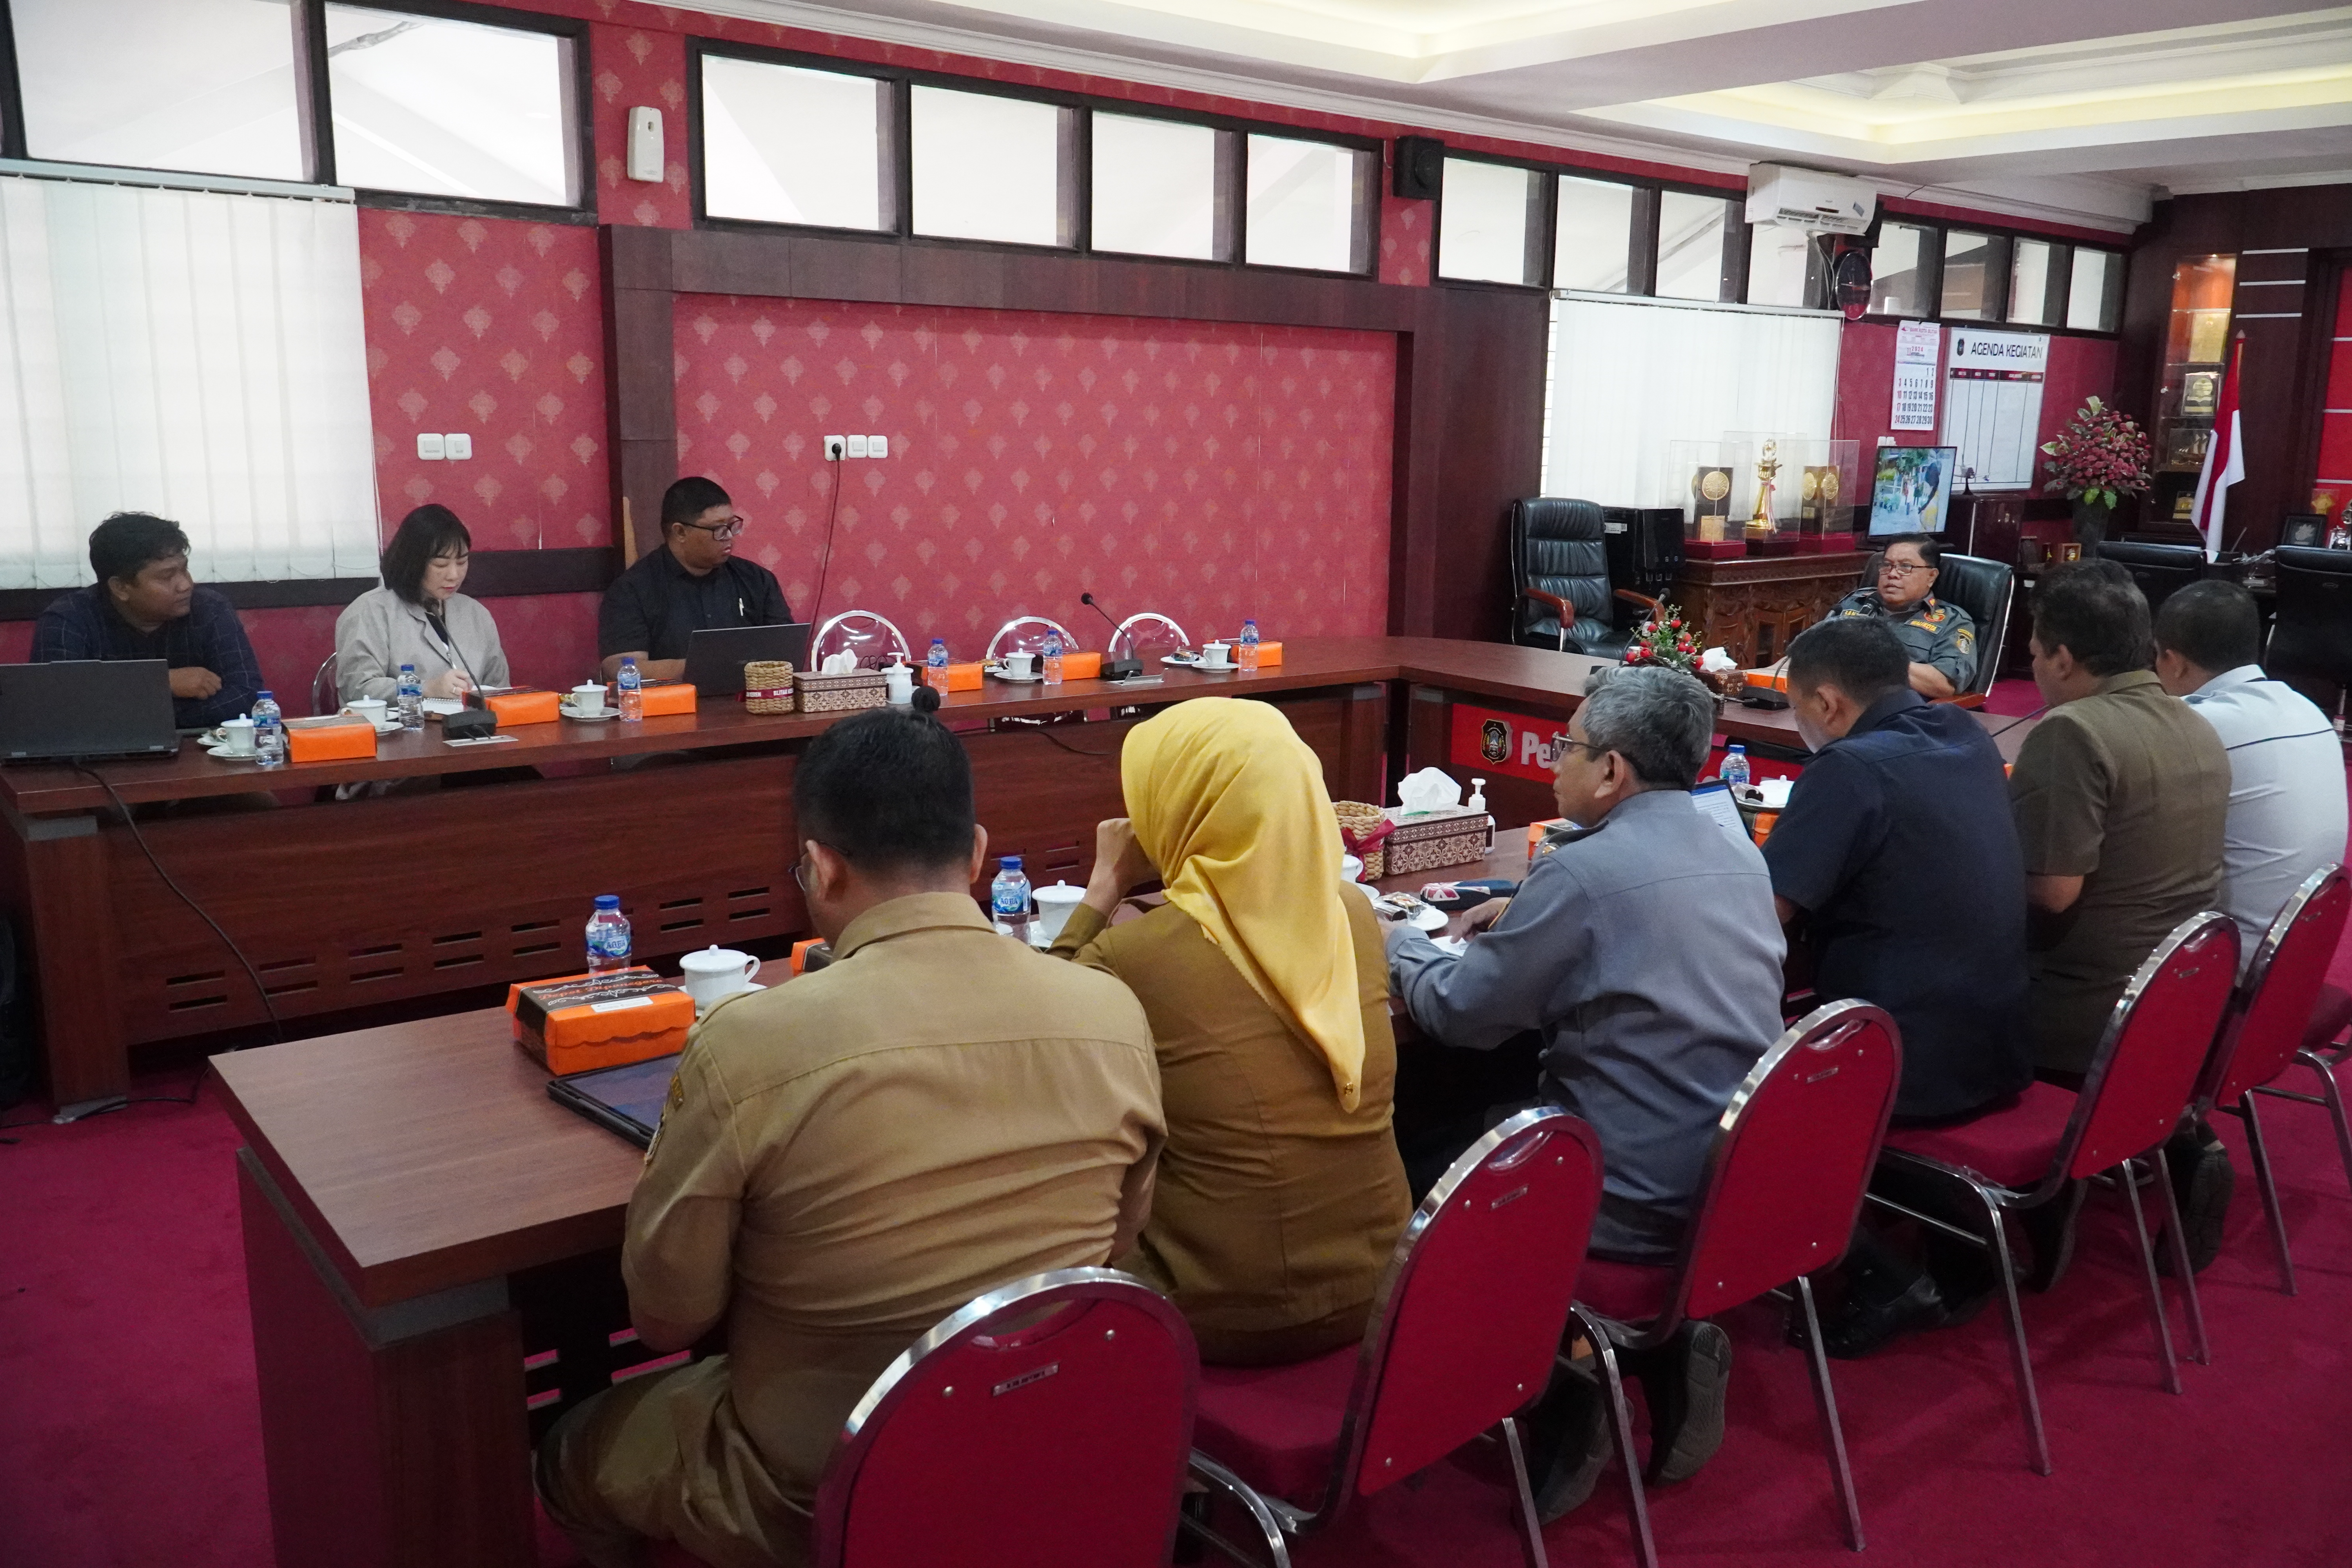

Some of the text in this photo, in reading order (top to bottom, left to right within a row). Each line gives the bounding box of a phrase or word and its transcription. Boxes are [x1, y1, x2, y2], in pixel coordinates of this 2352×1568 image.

[1907, 347, 1911, 356] 11
[1971, 342, 2043, 358] AGENDA KEGIATAN
[1927, 367, 1934, 376] 1 2
[1899, 378, 1901, 387] 3
[1909, 379, 1912, 387] 5
[1915, 379, 1918, 387] 6
[1920, 379, 1923, 388] 7
[1925, 379, 1928, 388] 8
[1931, 380, 1933, 388] 9
[1897, 390, 1933, 400] 10 11 12 13 14 15 16
[1897, 403, 1933, 412] 17 18 19 20 21 22 23
[1895, 415, 1932, 425] 24 25 26 27 28 29 30
[1910, 620, 1937, 632] WALIKOTA
[1521, 731, 1552, 769] Pe
